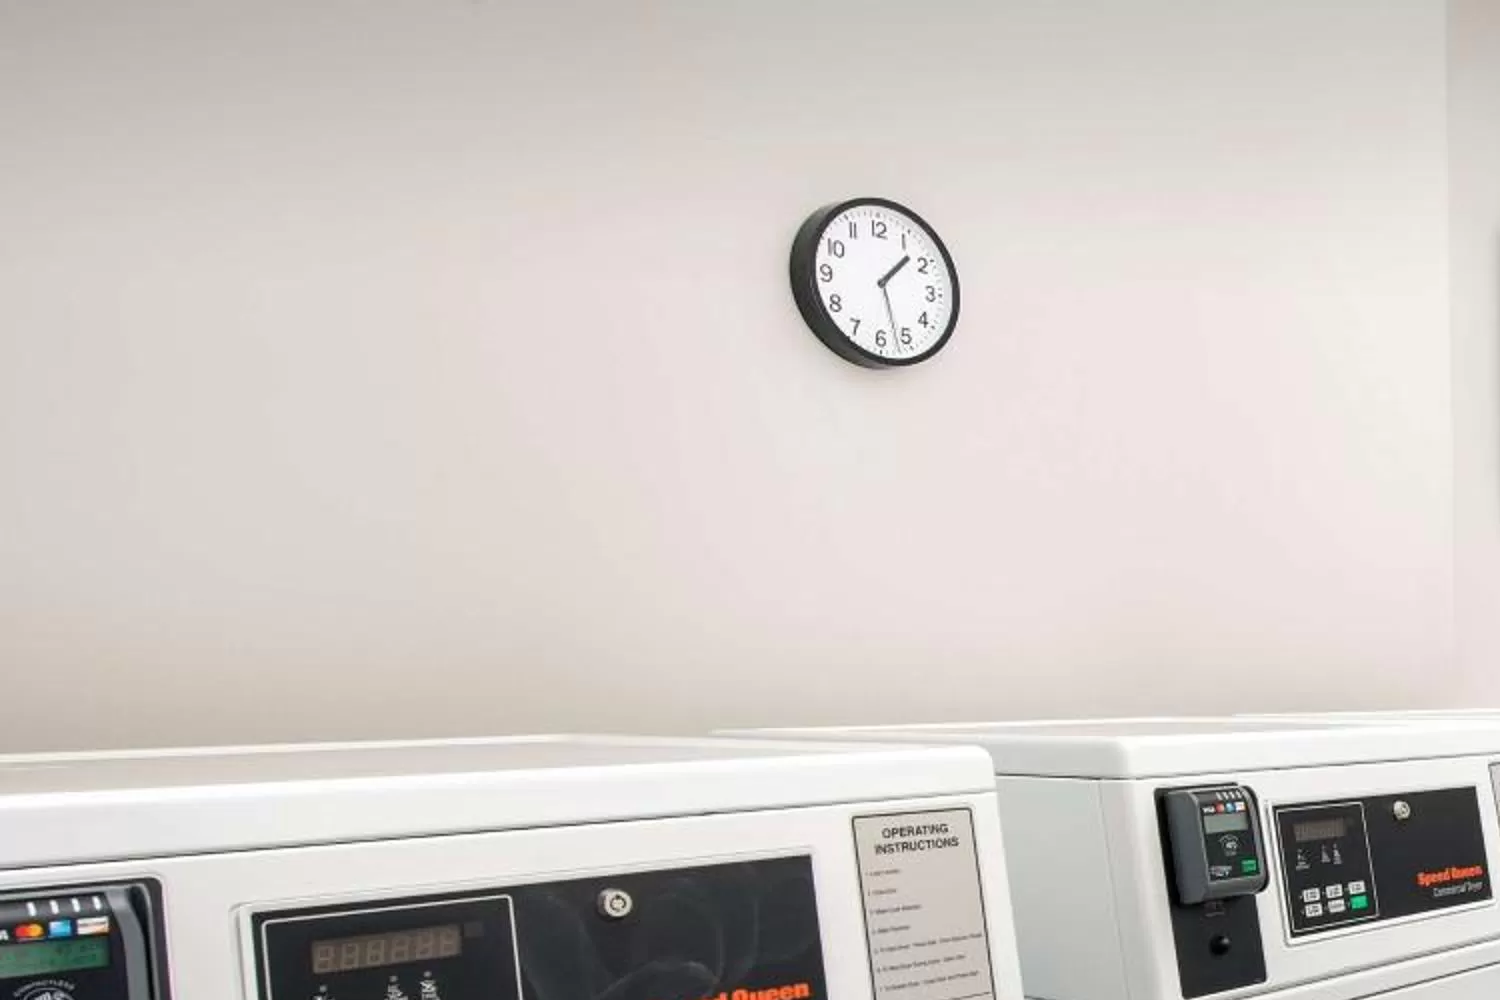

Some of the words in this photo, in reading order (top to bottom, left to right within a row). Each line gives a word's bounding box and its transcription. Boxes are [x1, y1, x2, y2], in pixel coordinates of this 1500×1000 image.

[849, 221, 858, 239] 11
[871, 220, 888, 240] 12
[827, 238, 845, 259] 10
[819, 263, 833, 282] 9
[916, 257, 929, 274] 2
[829, 293, 842, 312] 8
[924, 285, 937, 302] 3
[850, 318, 861, 337] 7
[917, 311, 929, 328] 4
[875, 329, 887, 347] 6
[900, 327, 913, 345] 5
[881, 823, 950, 839] OPERATING
[874, 836, 960, 855] INSTRUCTIONS
